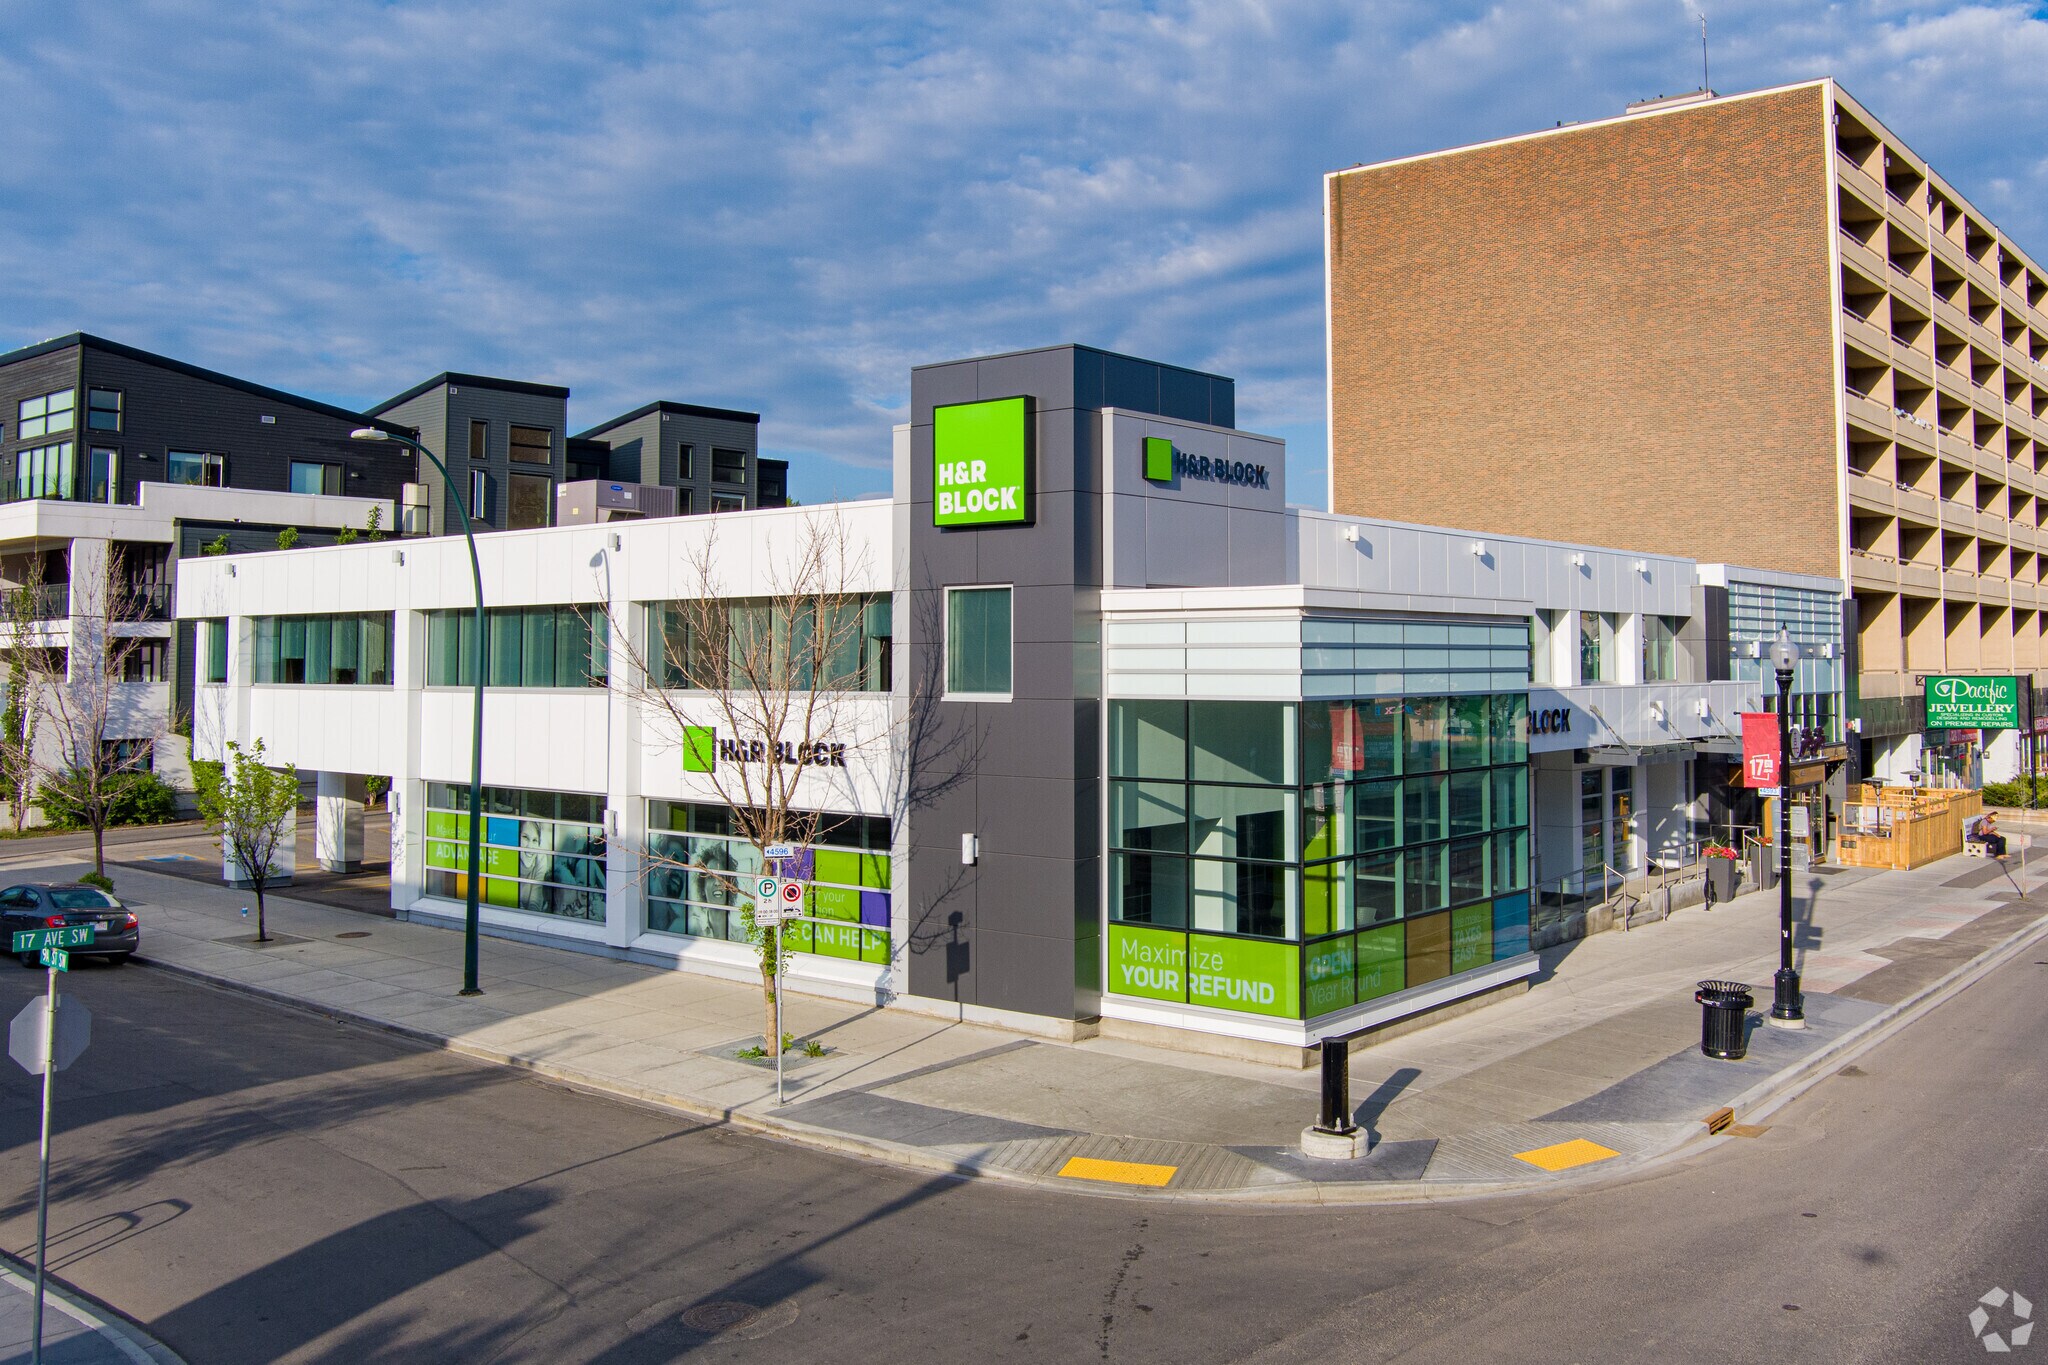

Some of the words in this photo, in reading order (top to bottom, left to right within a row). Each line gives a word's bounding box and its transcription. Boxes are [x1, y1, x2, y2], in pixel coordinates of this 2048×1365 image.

[939, 459, 986, 486] H&R
[1176, 452, 1209, 477] H&R
[1214, 458, 1266, 485] BLOCK
[939, 487, 1018, 515] BLOCK
[1934, 678, 2008, 704] Pacific
[1928, 703, 2015, 713] JEWELLERY
[773, 741, 847, 768] BLOCK
[1749, 758, 1764, 776] 17
[436, 843, 499, 865] ADVANAGE
[770, 848, 788, 856] 4596
[823, 892, 845, 903] your
[20, 934, 36, 948] 17
[44, 930, 65, 946] AVE
[71, 928, 88, 944] SW
[802, 924, 834, 944] CAN
[839, 928, 882, 950] HELP
[1455, 925, 1482, 946] TAXES
[42, 948, 50, 962] 9A
[52, 950, 58, 966] ST
[58, 953, 67, 968] SW
[1121, 938, 1224, 972] Maximize
[1309, 948, 1352, 981] OPEN
[1454, 944, 1477, 963] EASY
[1120, 964, 1180, 992] YOUR
[1185, 973, 1275, 1004] REFUND
[1309, 984, 1338, 1006] Year
[1341, 966, 1382, 998] Round
